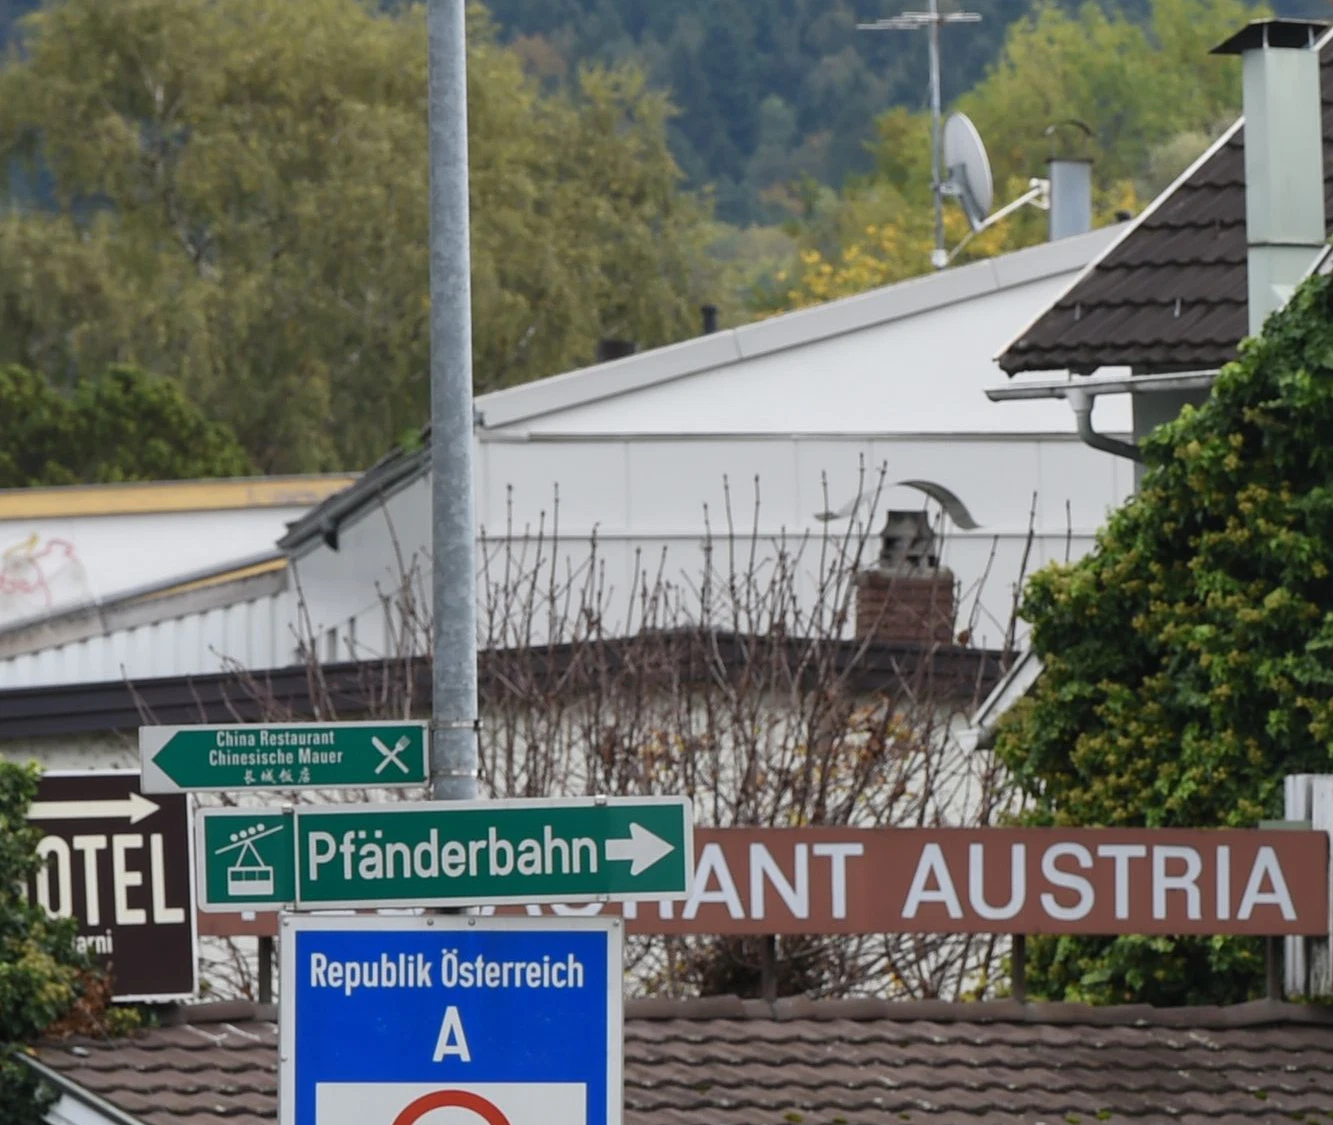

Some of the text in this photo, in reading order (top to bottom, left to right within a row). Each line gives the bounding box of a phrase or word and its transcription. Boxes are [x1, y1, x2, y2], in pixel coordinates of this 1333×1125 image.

[209, 749, 343, 766] Chinesische Mauer
[216, 730, 335, 746] China Restaurant
[308, 825, 598, 881] Pfänderbahn
[35, 833, 185, 926] OTEL
[903, 841, 1297, 921] AUSTRIA
[75, 928, 113, 955] arni
[310, 948, 584, 996] Republik Österreich
[432, 1005, 472, 1062] A
